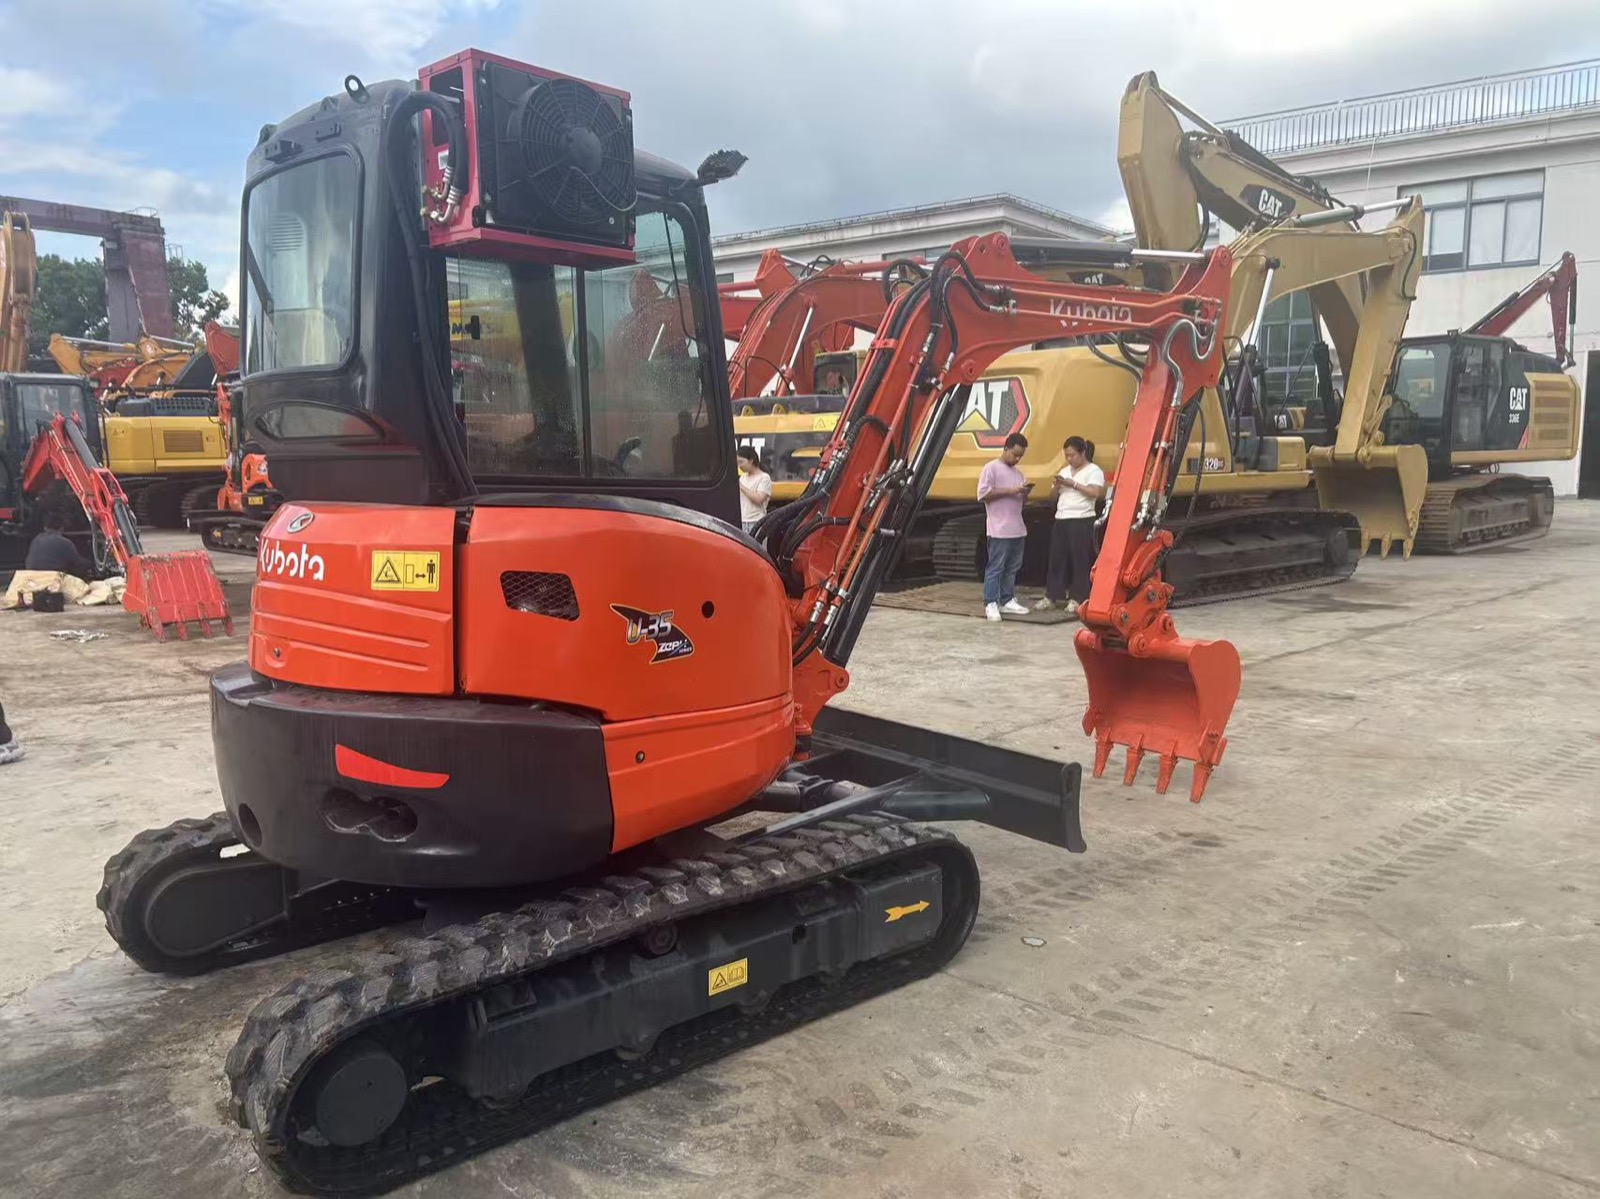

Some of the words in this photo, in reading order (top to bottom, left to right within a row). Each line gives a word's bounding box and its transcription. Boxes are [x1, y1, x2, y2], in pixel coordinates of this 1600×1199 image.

[1259, 189, 1282, 218] CAT
[1049, 298, 1132, 328] Kubota
[956, 380, 1010, 431] AT
[1510, 387, 1527, 411] CAT
[259, 537, 325, 581] Kubota
[627, 612, 673, 643] U-35
